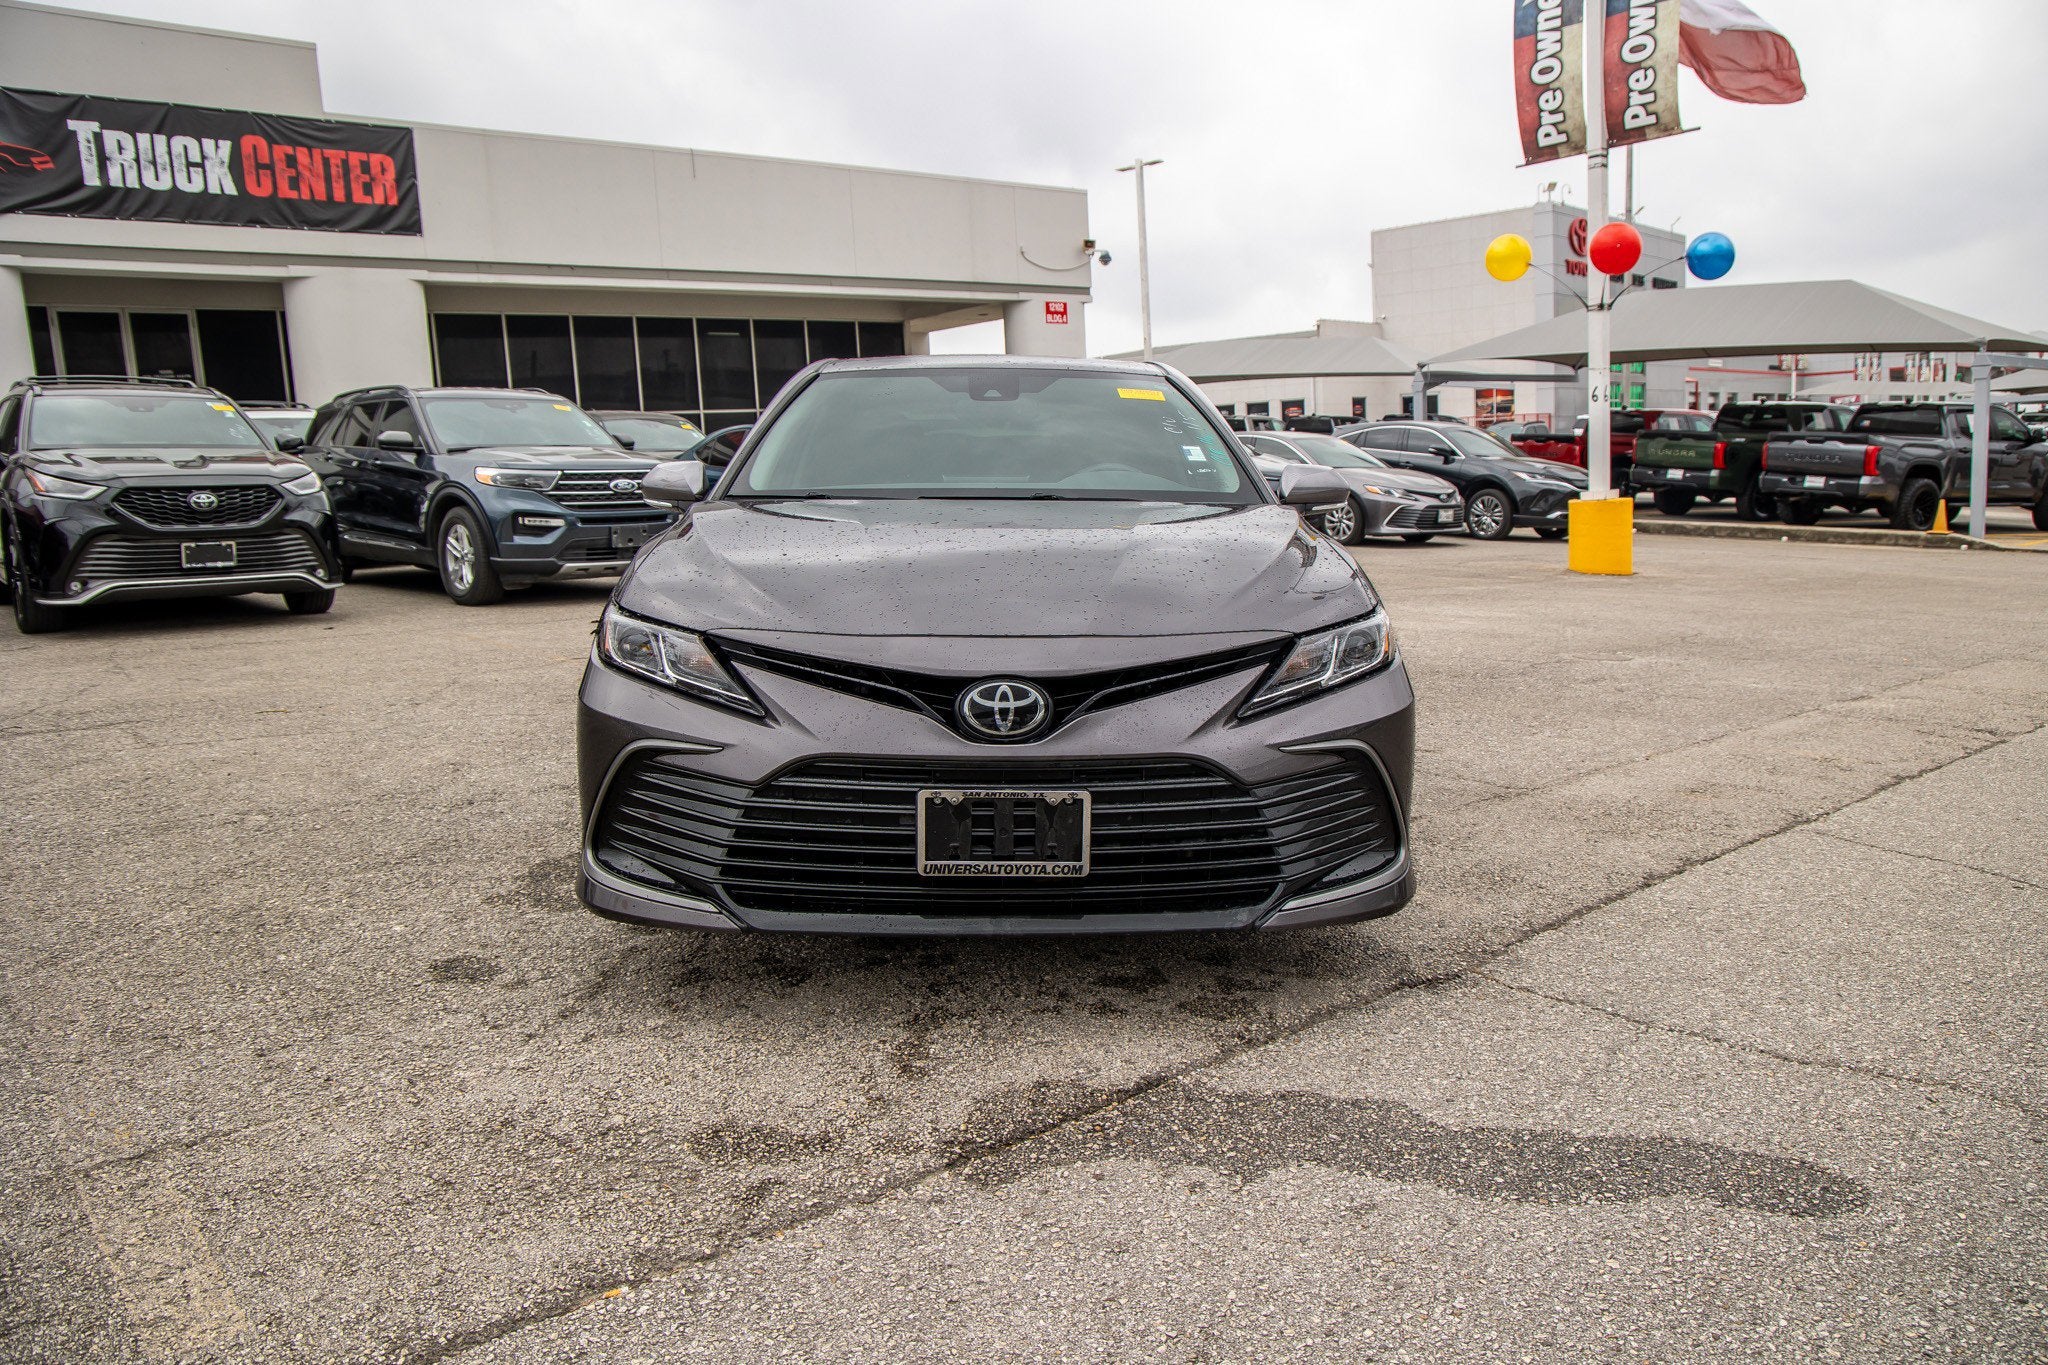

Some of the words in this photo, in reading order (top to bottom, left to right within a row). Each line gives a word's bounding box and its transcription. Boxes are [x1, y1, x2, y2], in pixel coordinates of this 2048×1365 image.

[1536, 88, 1569, 148] Pre
[1623, 67, 1658, 130] Pre
[67, 119, 238, 196] TRUCK
[239, 134, 399, 206] CENTER
[923, 863, 1084, 876] UNIVERSALTOYOTA.COM
